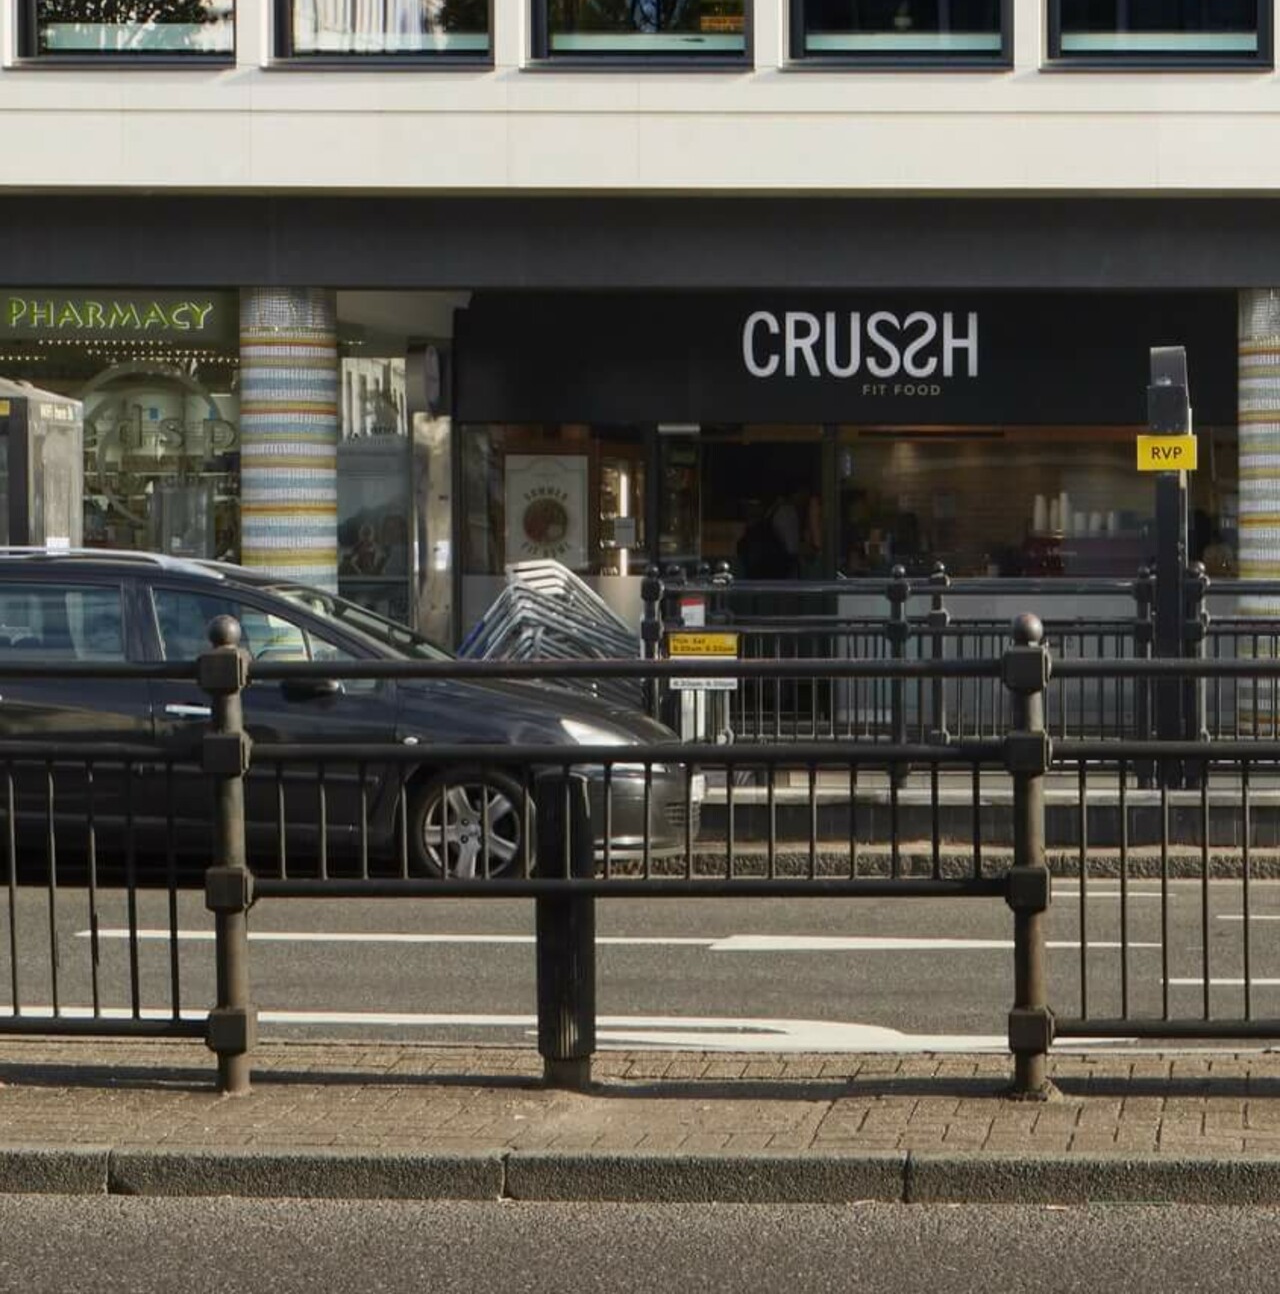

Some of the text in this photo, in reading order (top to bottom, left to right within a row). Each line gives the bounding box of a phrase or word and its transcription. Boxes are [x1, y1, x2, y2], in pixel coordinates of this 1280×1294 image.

[8, 297, 213, 330] PHARMACY
[742, 310, 978, 378] CRUSSH
[862, 384, 942, 396] FIT FOOD
[1150, 445, 1183, 460] RVP
